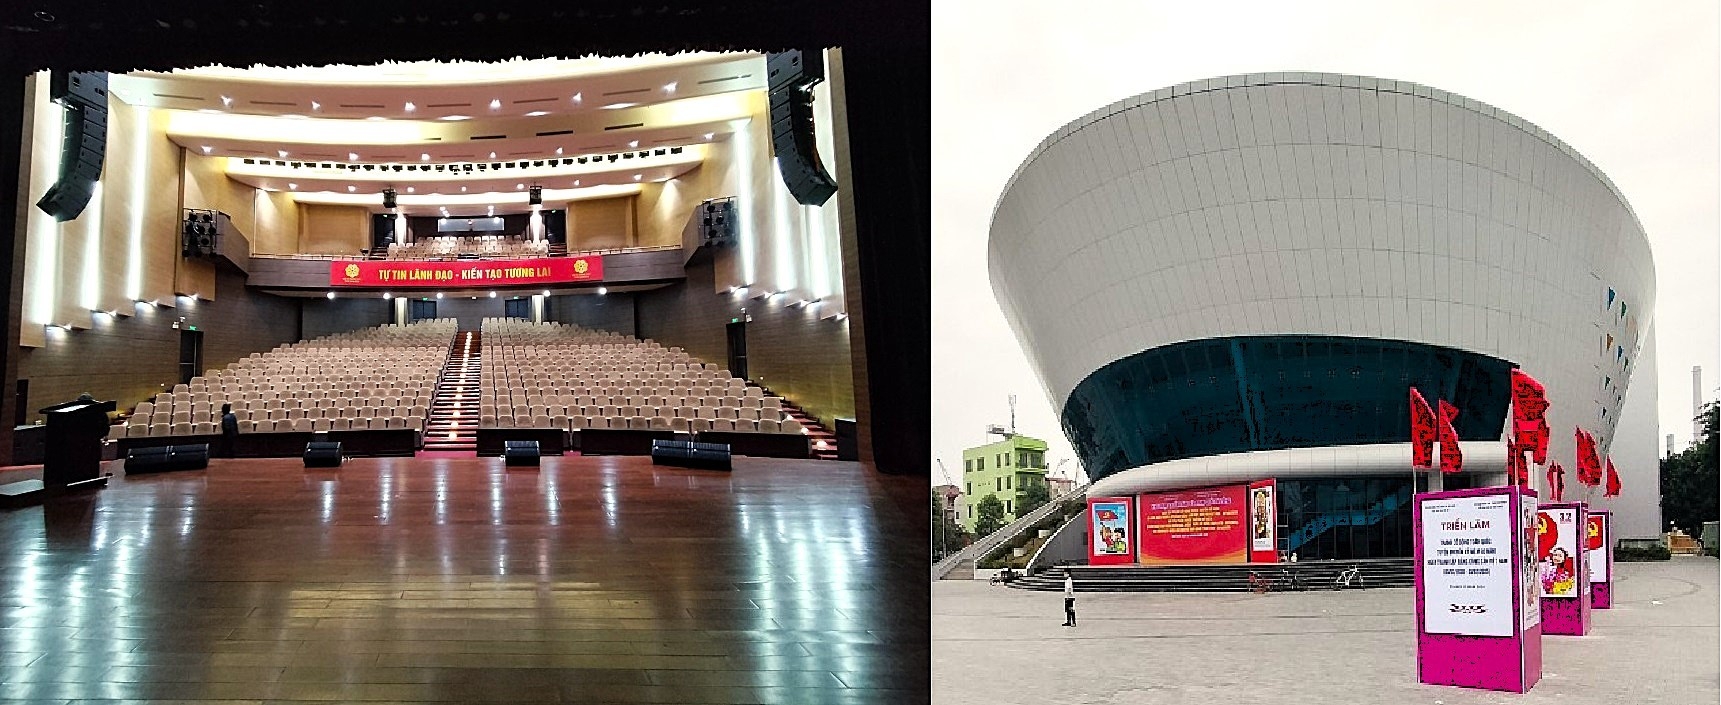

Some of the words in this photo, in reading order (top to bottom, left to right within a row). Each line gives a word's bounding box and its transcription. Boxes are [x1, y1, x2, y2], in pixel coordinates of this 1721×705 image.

[379, 269, 392, 282] TỰ
[392, 269, 407, 280] TIN
[409, 268, 433, 280] LÃNH
[435, 269, 453, 282] ĐẠO
[461, 266, 483, 280] KIẾN
[485, 269, 503, 281] TẠO
[504, 267, 535, 279] TƯƠNG
[537, 267, 552, 278] LAI
